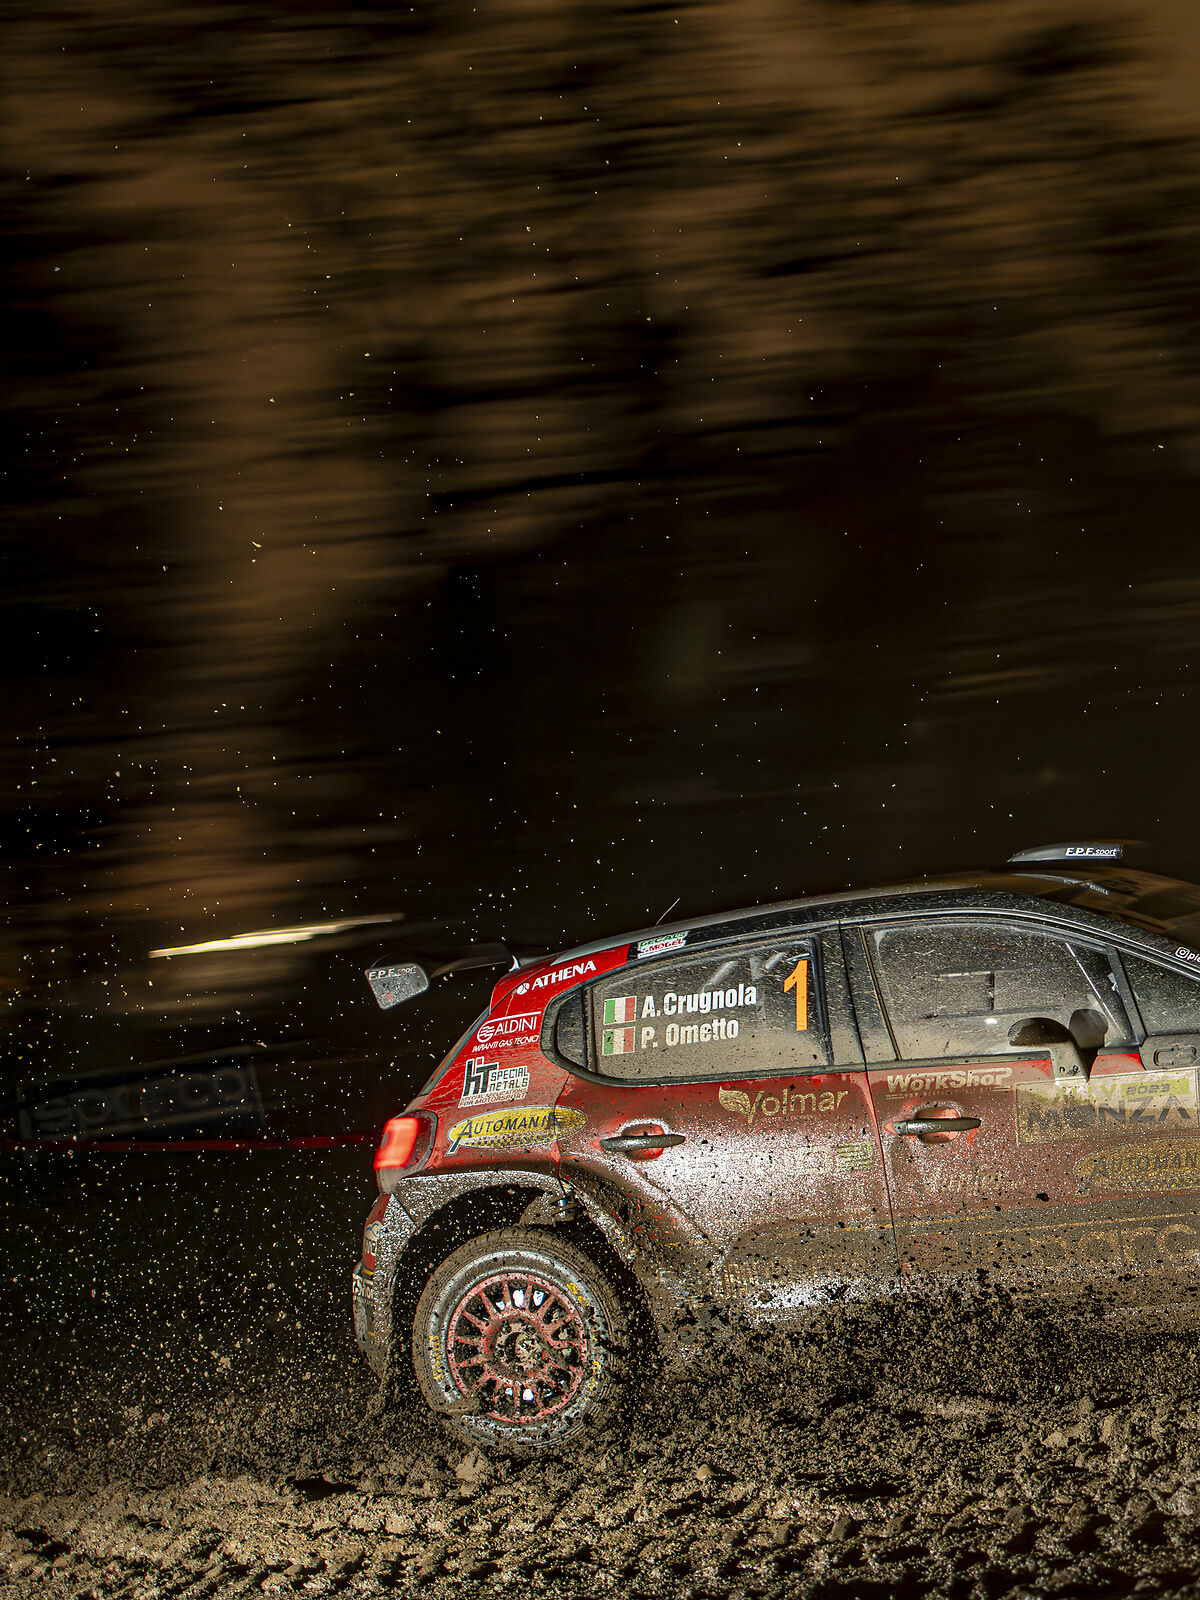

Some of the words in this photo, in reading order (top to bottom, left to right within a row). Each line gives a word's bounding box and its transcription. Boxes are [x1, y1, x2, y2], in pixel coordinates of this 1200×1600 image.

[532, 960, 598, 991] ATHENA
[784, 959, 808, 1032] 1
[494, 1016, 538, 1037] ALDINI
[641, 1027, 659, 1049] P.
[666, 1018, 740, 1047] Ometto
[499, 1037, 514, 1048] GAS
[514, 1034, 540, 1046] TECNICI
[490, 1067, 527, 1082] SPECIAL
[1125, 1082, 1170, 1097] 2023
[719, 1086, 849, 1125] Volmar
